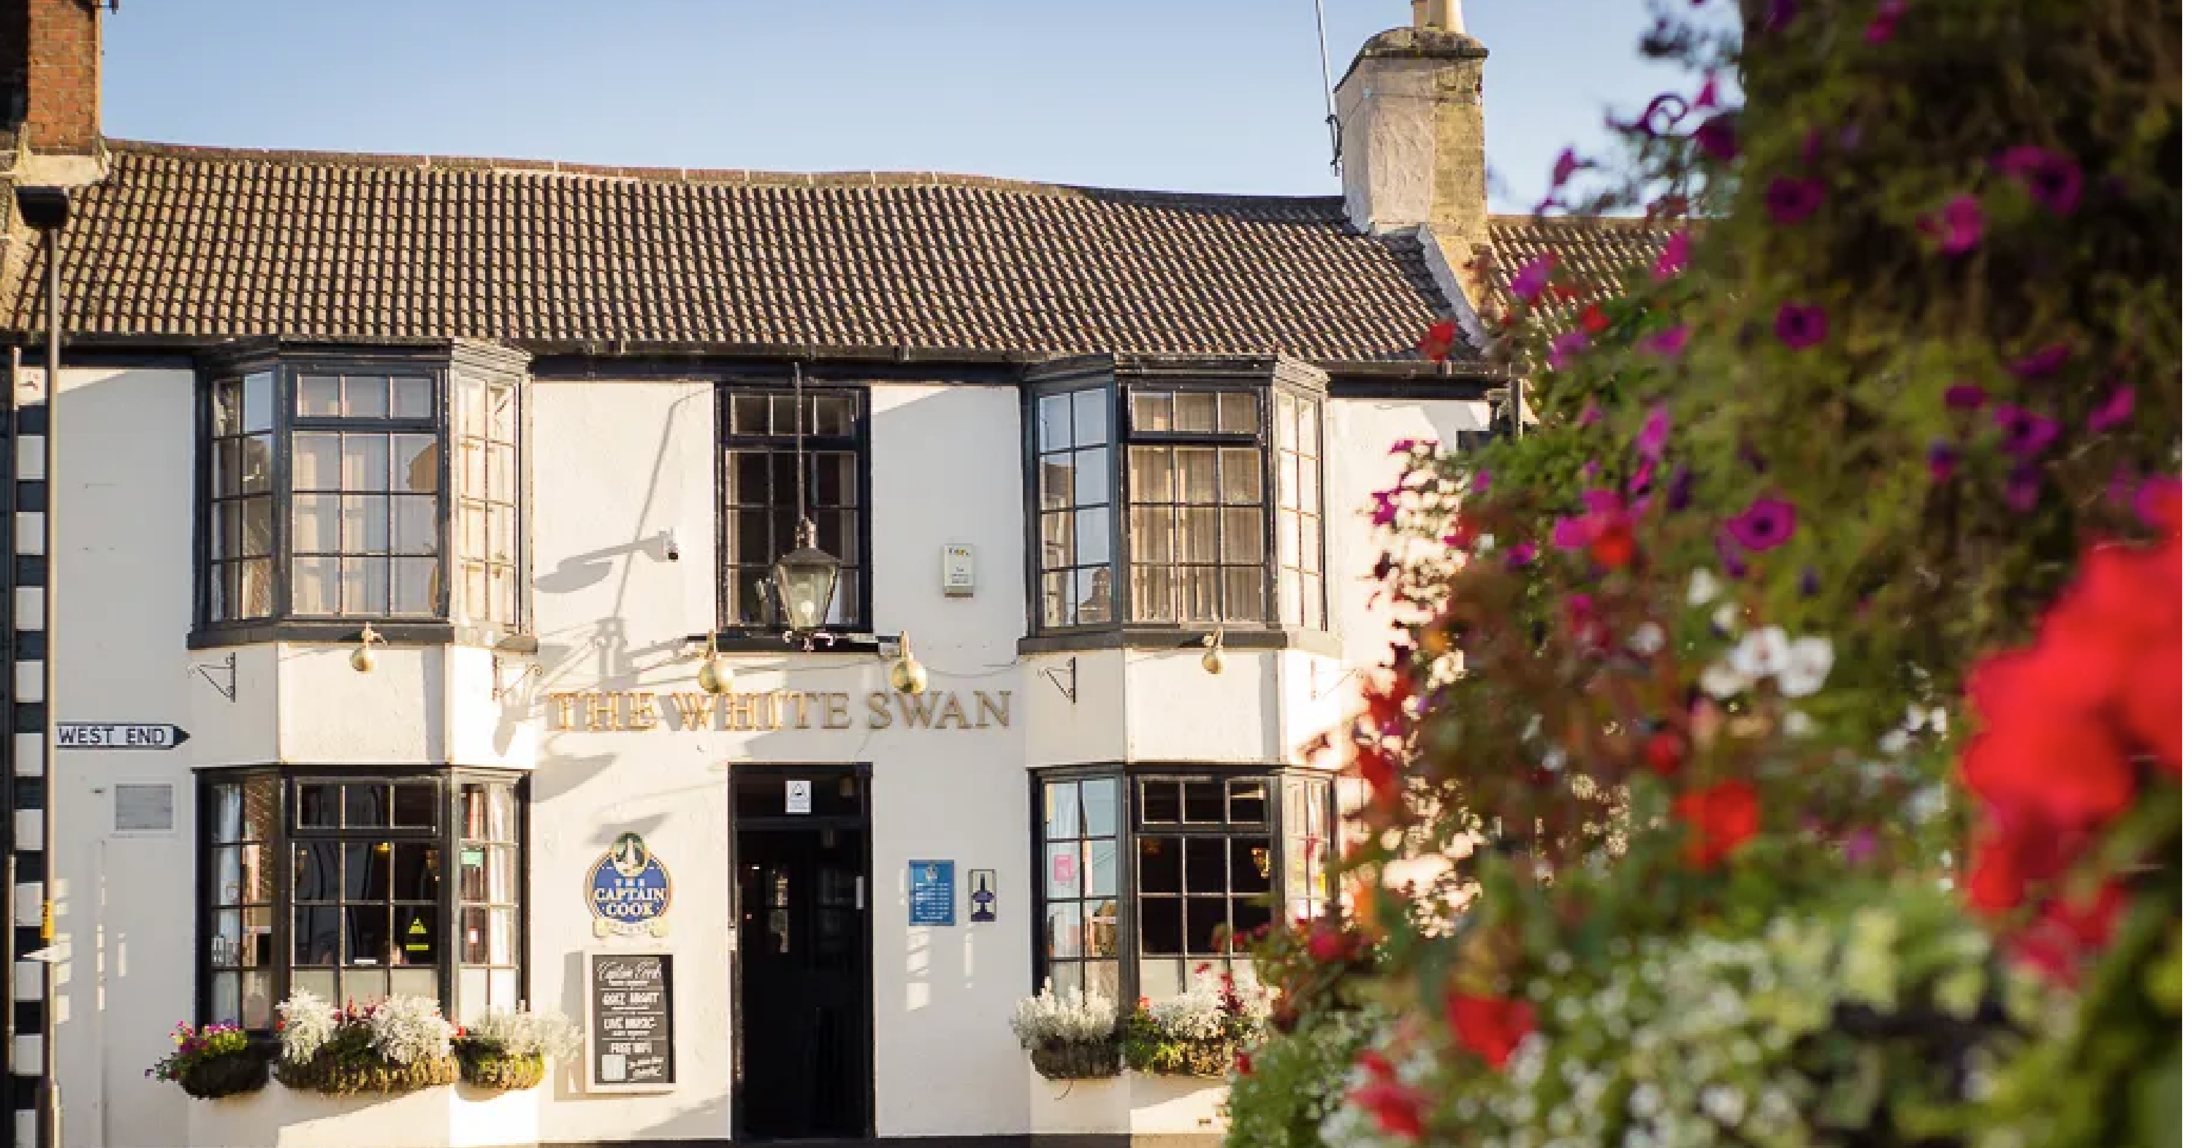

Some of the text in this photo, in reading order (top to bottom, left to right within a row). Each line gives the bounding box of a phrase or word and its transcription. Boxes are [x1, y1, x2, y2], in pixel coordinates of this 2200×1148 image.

[548, 690, 1012, 731] THE WHITE SWAN
[58, 728, 165, 744] WEST END
[614, 878, 645, 887] THE
[594, 887, 665, 900] CAPTAIN
[605, 902, 655, 915] COOK
